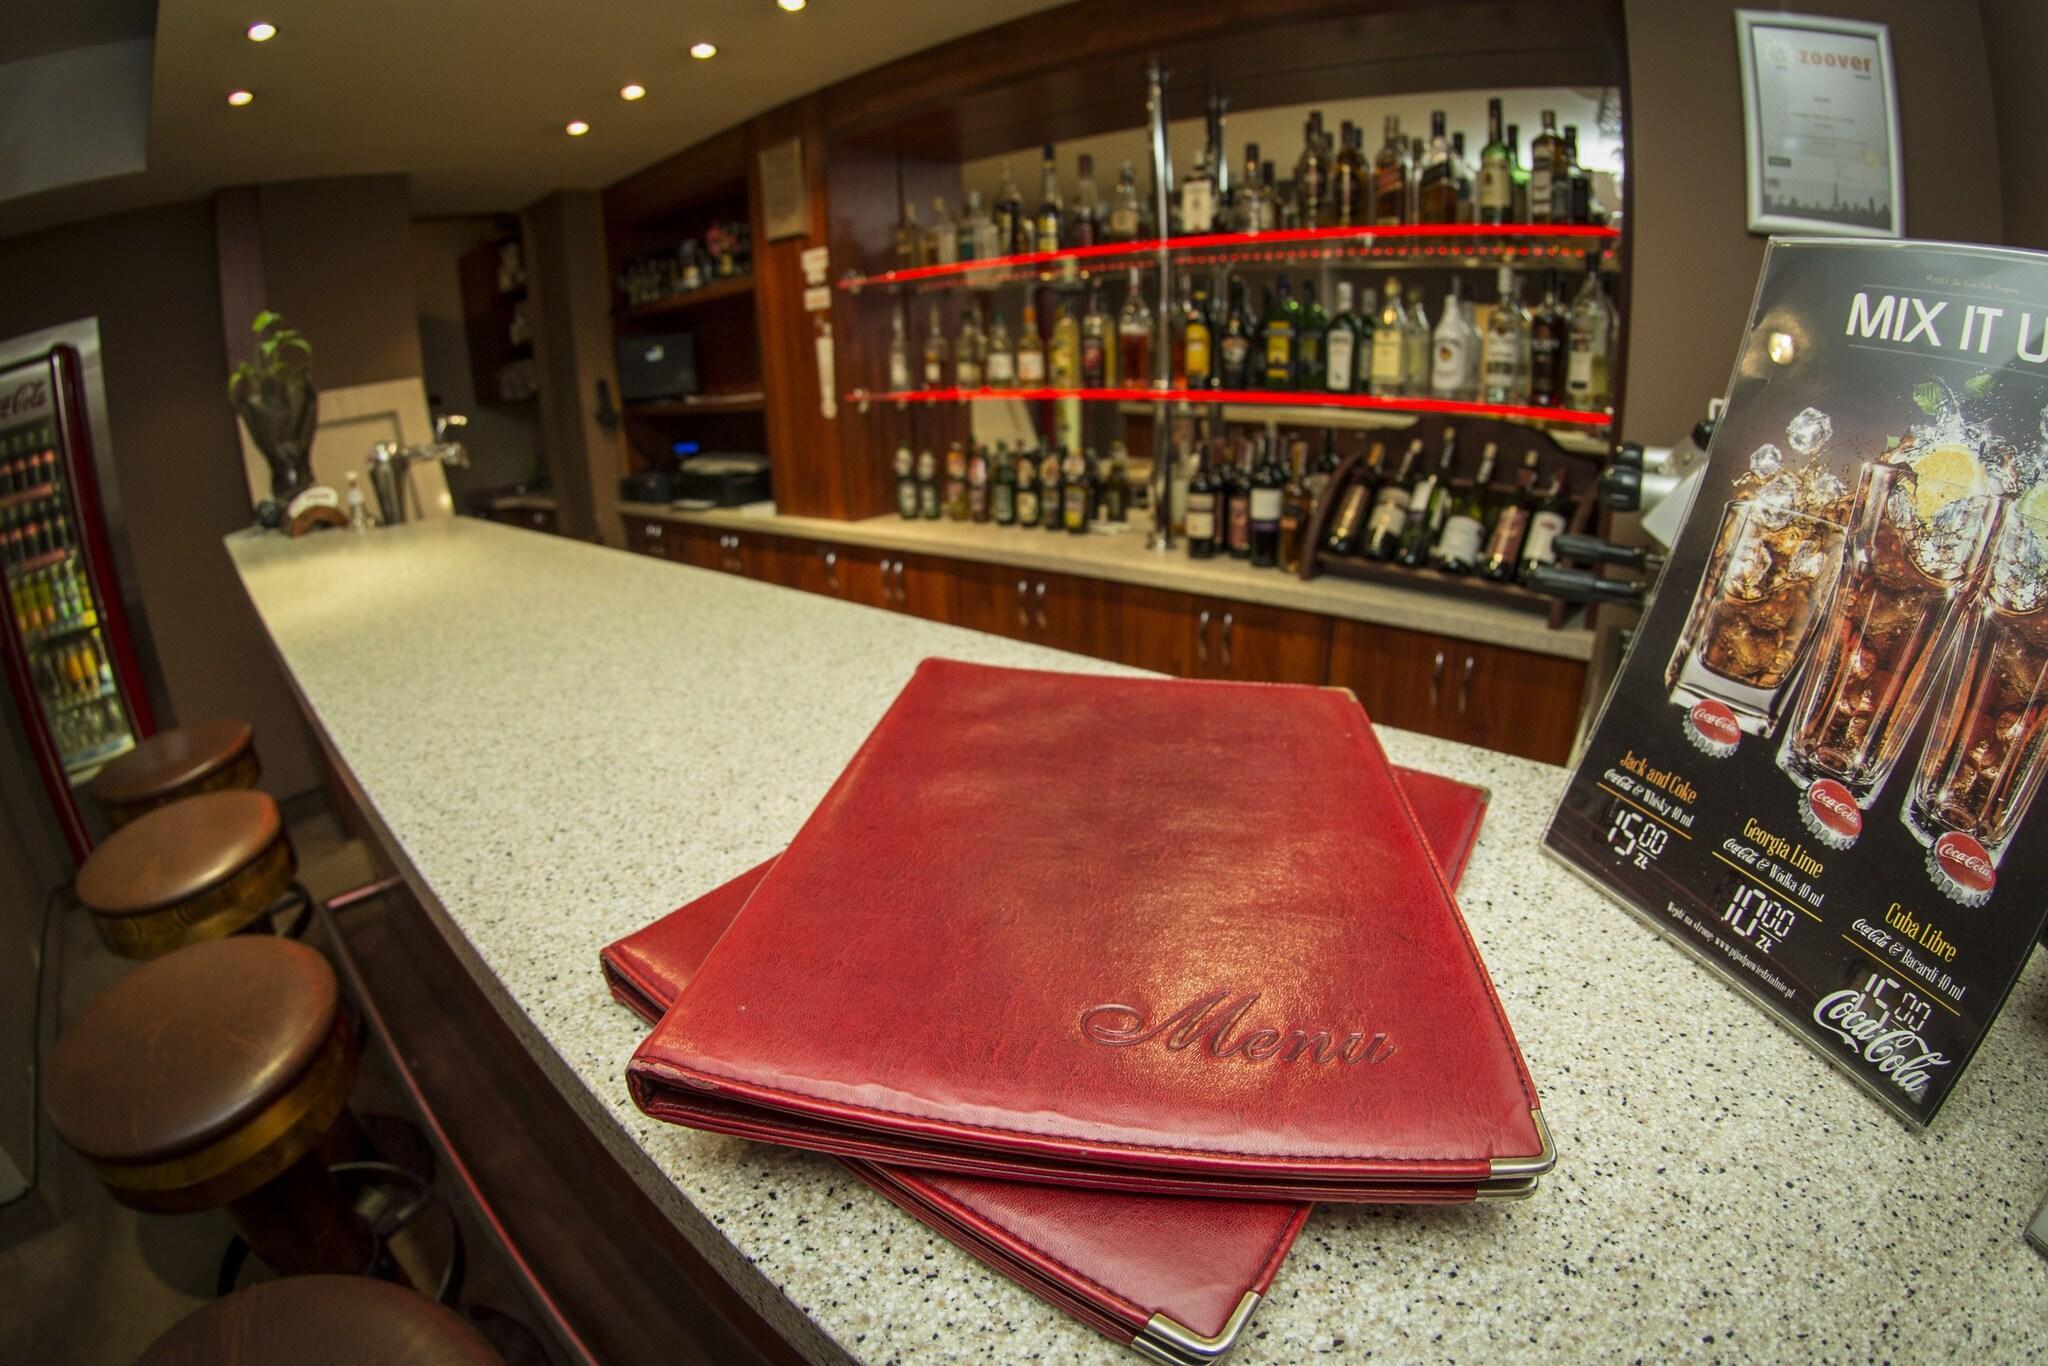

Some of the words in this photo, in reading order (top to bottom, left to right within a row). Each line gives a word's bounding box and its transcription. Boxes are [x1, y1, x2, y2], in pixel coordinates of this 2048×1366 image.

[1799, 49, 1874, 73] zoover
[1846, 292, 1948, 347] MIX
[1960, 304, 2003, 353] IT
[1694, 709, 1737, 734] Coca-Cola
[1620, 750, 1648, 777] Jack
[1646, 767, 1673, 790] and
[1668, 776, 1697, 804] Coke
[1811, 789, 1857, 825] Coca-Cola
[1643, 789, 1672, 816] Whisky
[1679, 815, 1695, 828] ml
[1723, 838, 1760, 864] Coca-Cola
[1769, 863, 1798, 892] Wódka
[1797, 882, 1811, 899] 40
[1808, 893, 1825, 908] ml
[1743, 817, 1791, 860] Georgia
[1789, 844, 1824, 879] Lime
[1938, 843, 1992, 880] Coca-Cola
[1852, 918, 1893, 948] Coca-Cola
[1888, 942, 1904, 956] &
[1900, 948, 1939, 983] Bacardi
[1937, 973, 1952, 992] 40
[1947, 986, 1967, 1001] ml
[1885, 902, 1919, 940] Cuba
[1919, 923, 1957, 962] Libre
[1080, 990, 1397, 1065] Menu
[1813, 989, 1951, 1092] Coca-Cola
